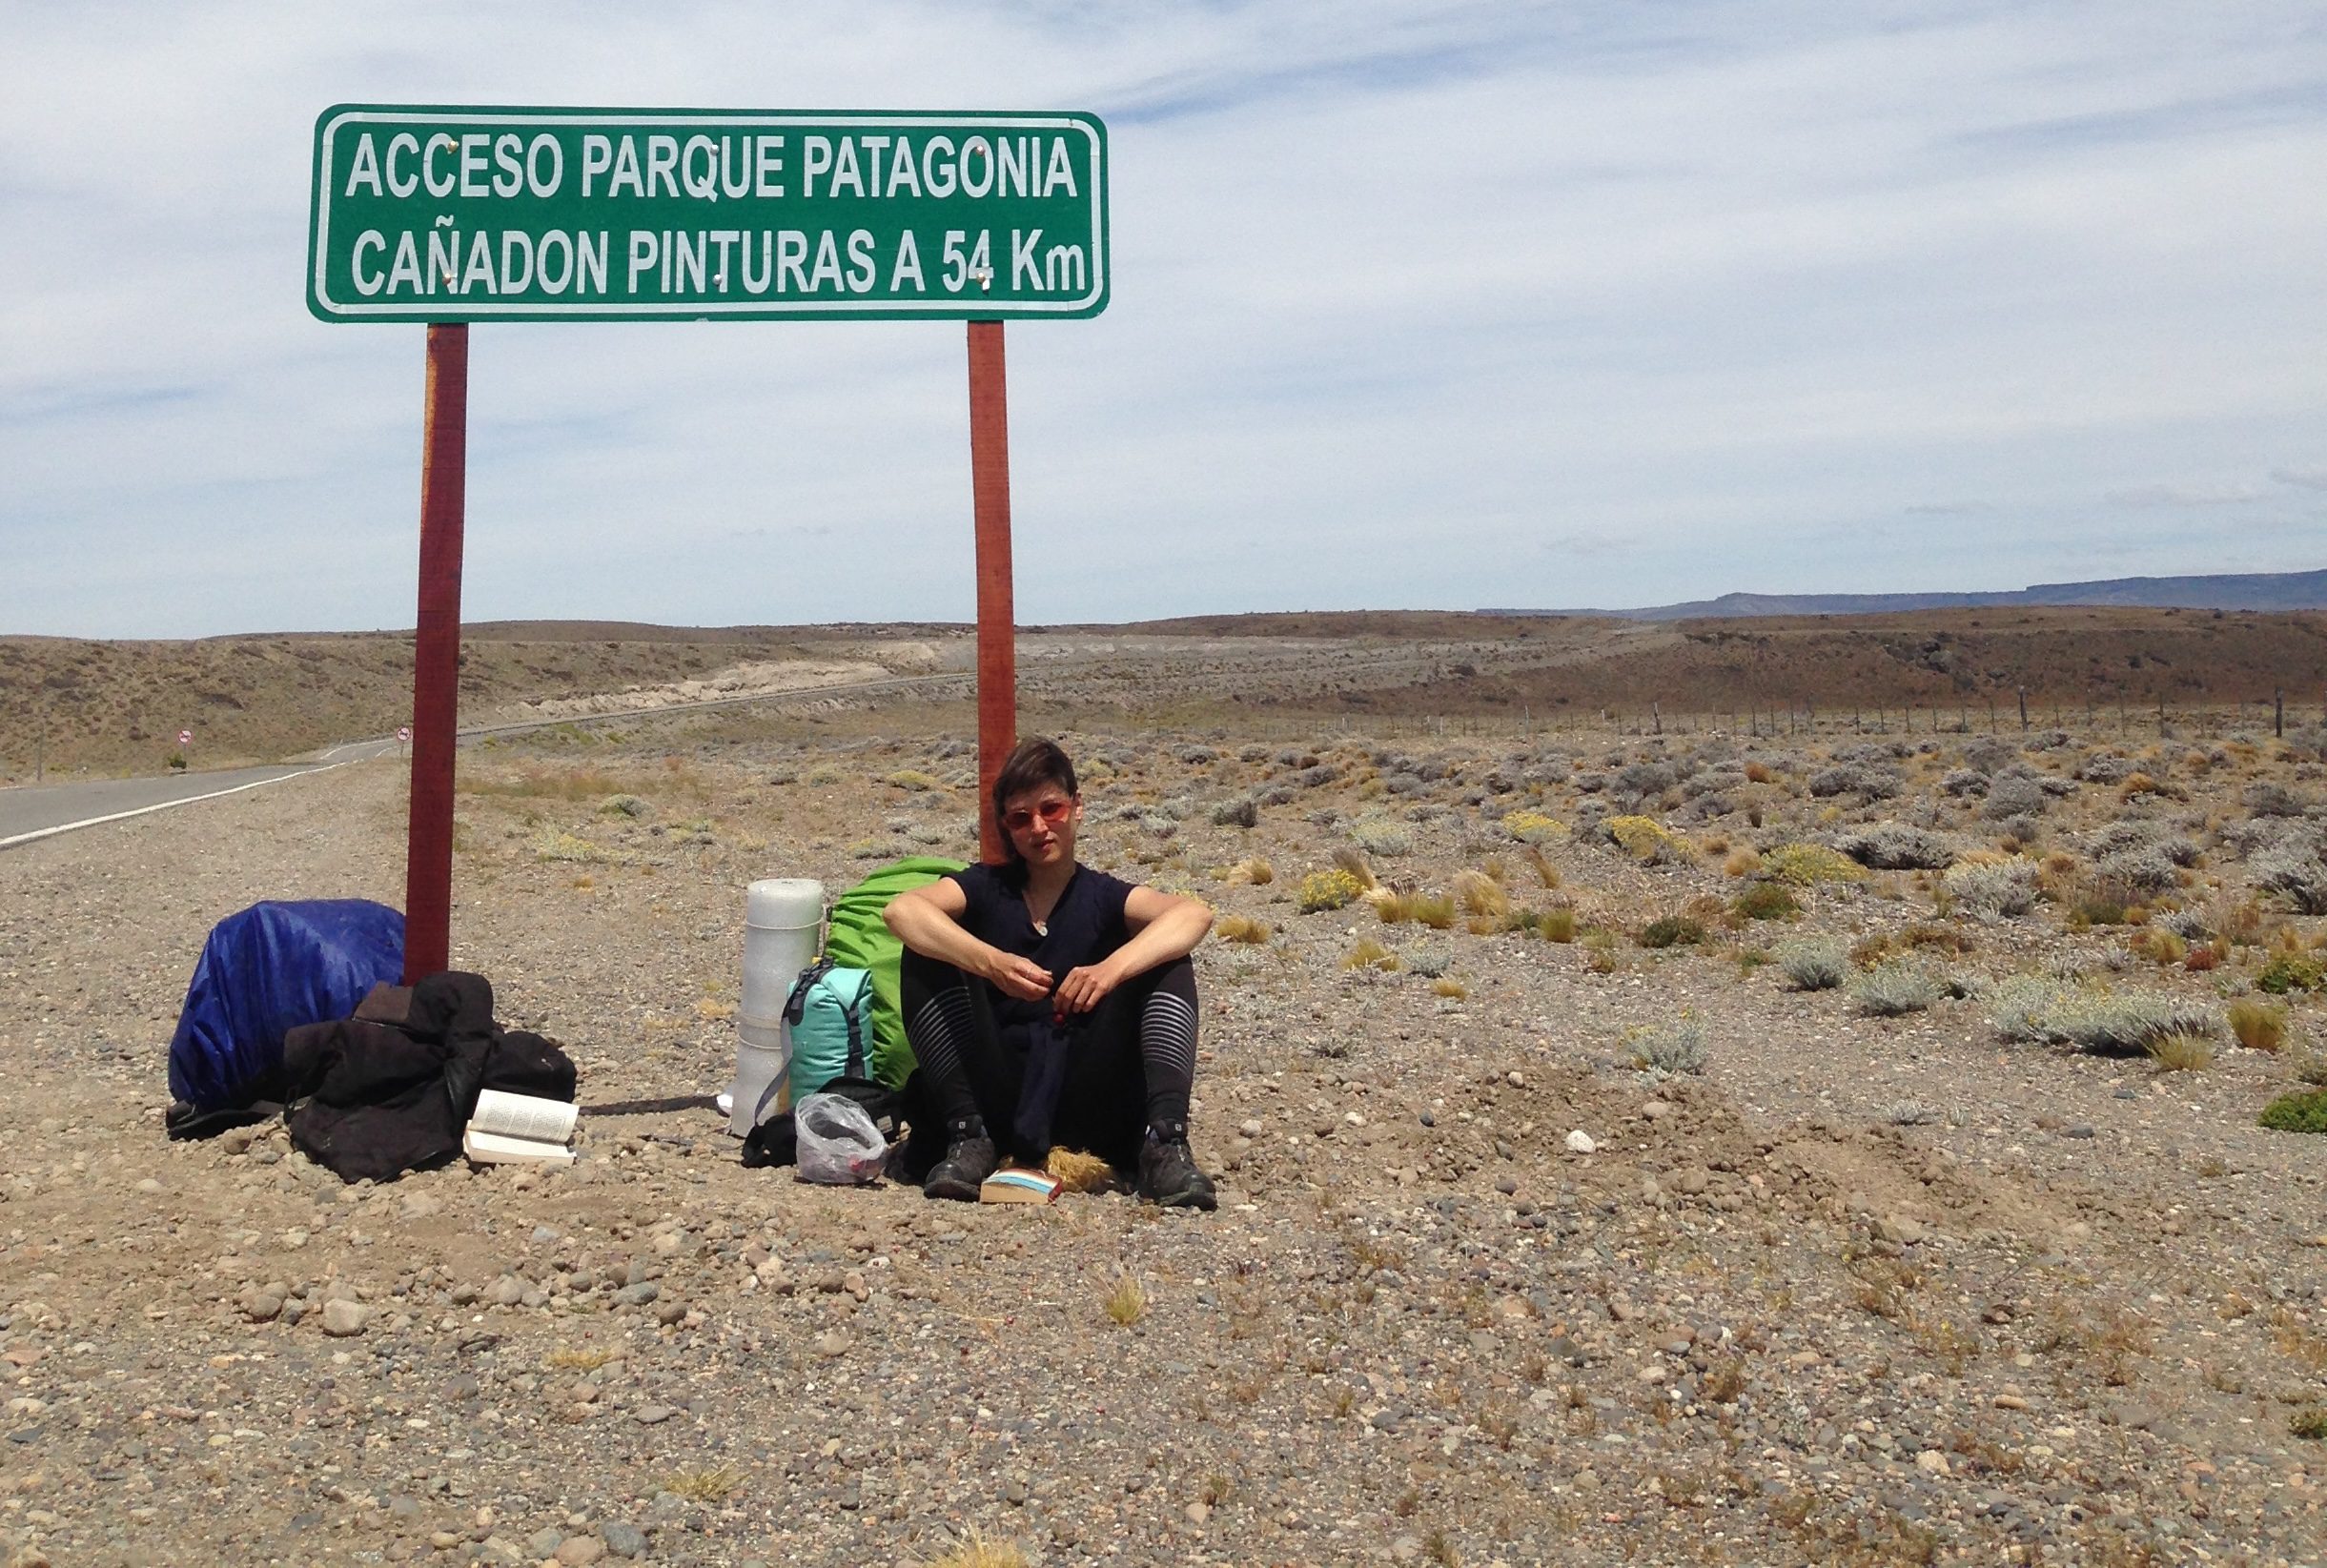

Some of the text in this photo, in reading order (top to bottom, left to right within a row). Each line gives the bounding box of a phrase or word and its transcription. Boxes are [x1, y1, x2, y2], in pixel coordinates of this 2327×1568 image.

[344, 132, 1078, 203] ACCESO PARQUE PATAGONIA
[352, 214, 1086, 295] CAÑADON PINTURAS A 54 Km
